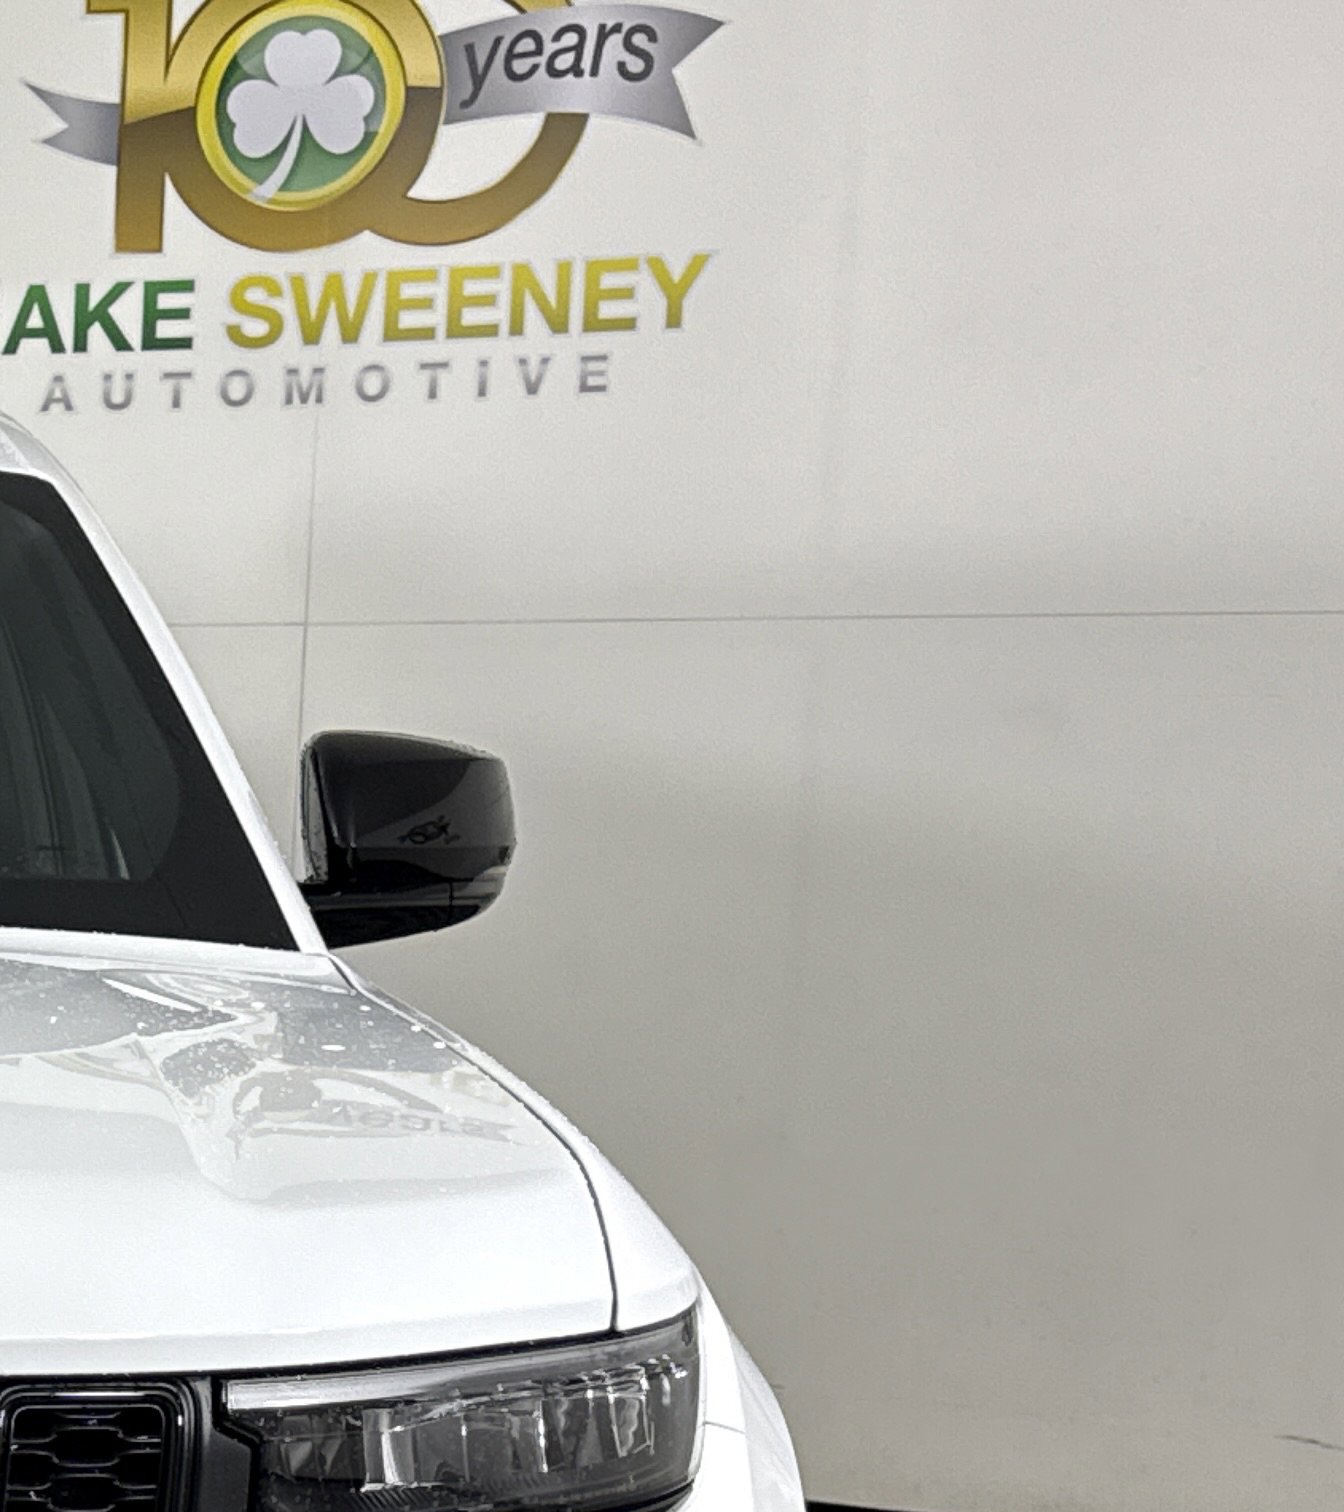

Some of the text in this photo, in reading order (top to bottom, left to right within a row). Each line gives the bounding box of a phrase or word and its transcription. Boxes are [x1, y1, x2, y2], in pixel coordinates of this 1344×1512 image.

[458, 22, 658, 108] years
[224, 253, 711, 350] SWEENEY
[40, 353, 610, 414] AUTOMOTIVE
